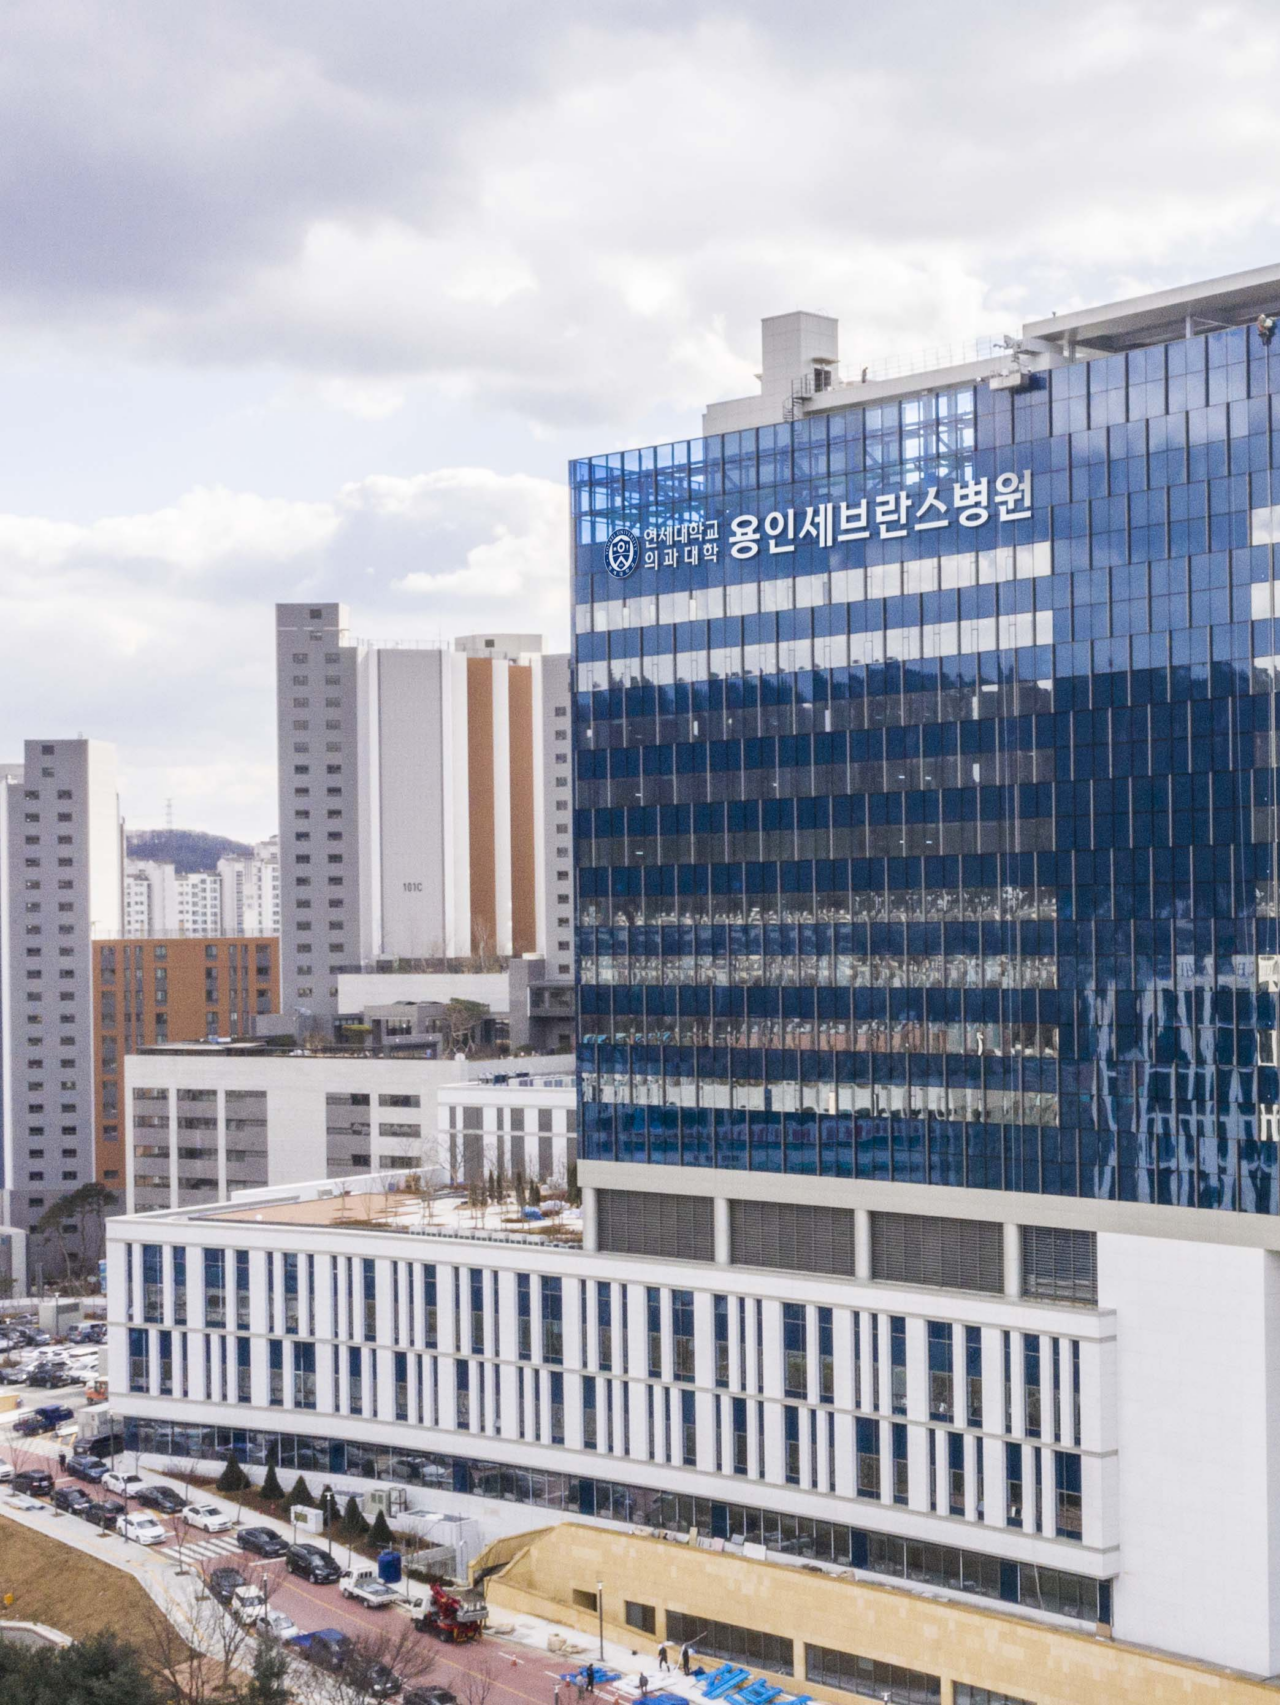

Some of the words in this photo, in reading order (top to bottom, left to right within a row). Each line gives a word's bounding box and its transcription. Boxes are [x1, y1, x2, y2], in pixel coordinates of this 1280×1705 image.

[728, 468, 1033, 560] 용인세브란스병원
[644, 520, 719, 548] 연세대학교
[644, 543, 719, 571] 의과대학
